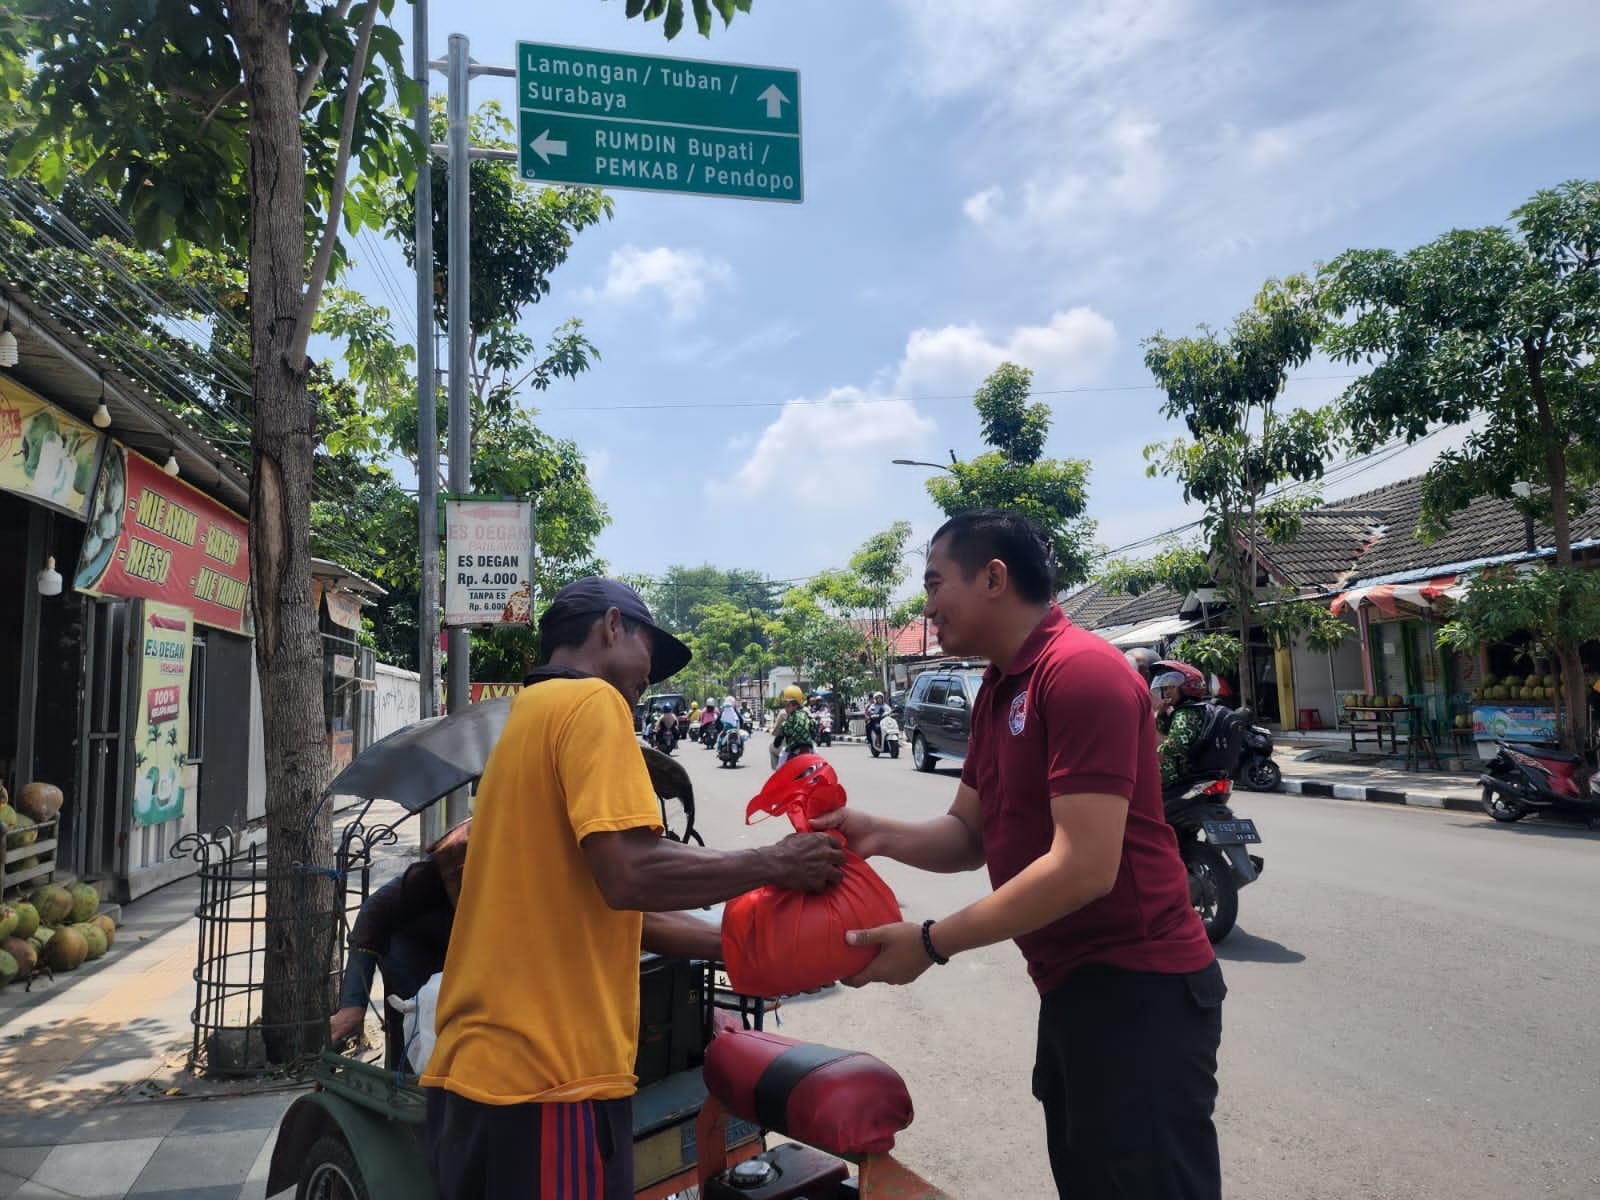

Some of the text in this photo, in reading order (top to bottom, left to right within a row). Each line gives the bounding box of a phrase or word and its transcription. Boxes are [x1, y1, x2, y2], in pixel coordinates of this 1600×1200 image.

[527, 54, 638, 85] Lamongan
[661, 68, 722, 91] Tuban
[527, 82, 627, 112] Surabaya
[595, 130, 676, 154] RUMDIN
[688, 138, 753, 163] Bupati
[595, 157, 679, 181] PEMKAB
[704, 166, 794, 193] Pendopo
[136, 487, 167, 534] MIE
[161, 501, 199, 548] AYAM
[448, 525, 529, 541] ES DEGAN
[124, 536, 172, 586] MIESO
[458, 555, 519, 567] ES DEGAN
[193, 566, 220, 601] MIE
[457, 573, 517, 587] Rp. 4.000
[469, 592, 506, 600] TANPA ES
[469, 602, 482, 612] Rp.
[159, 641, 186, 660] DEGAN
